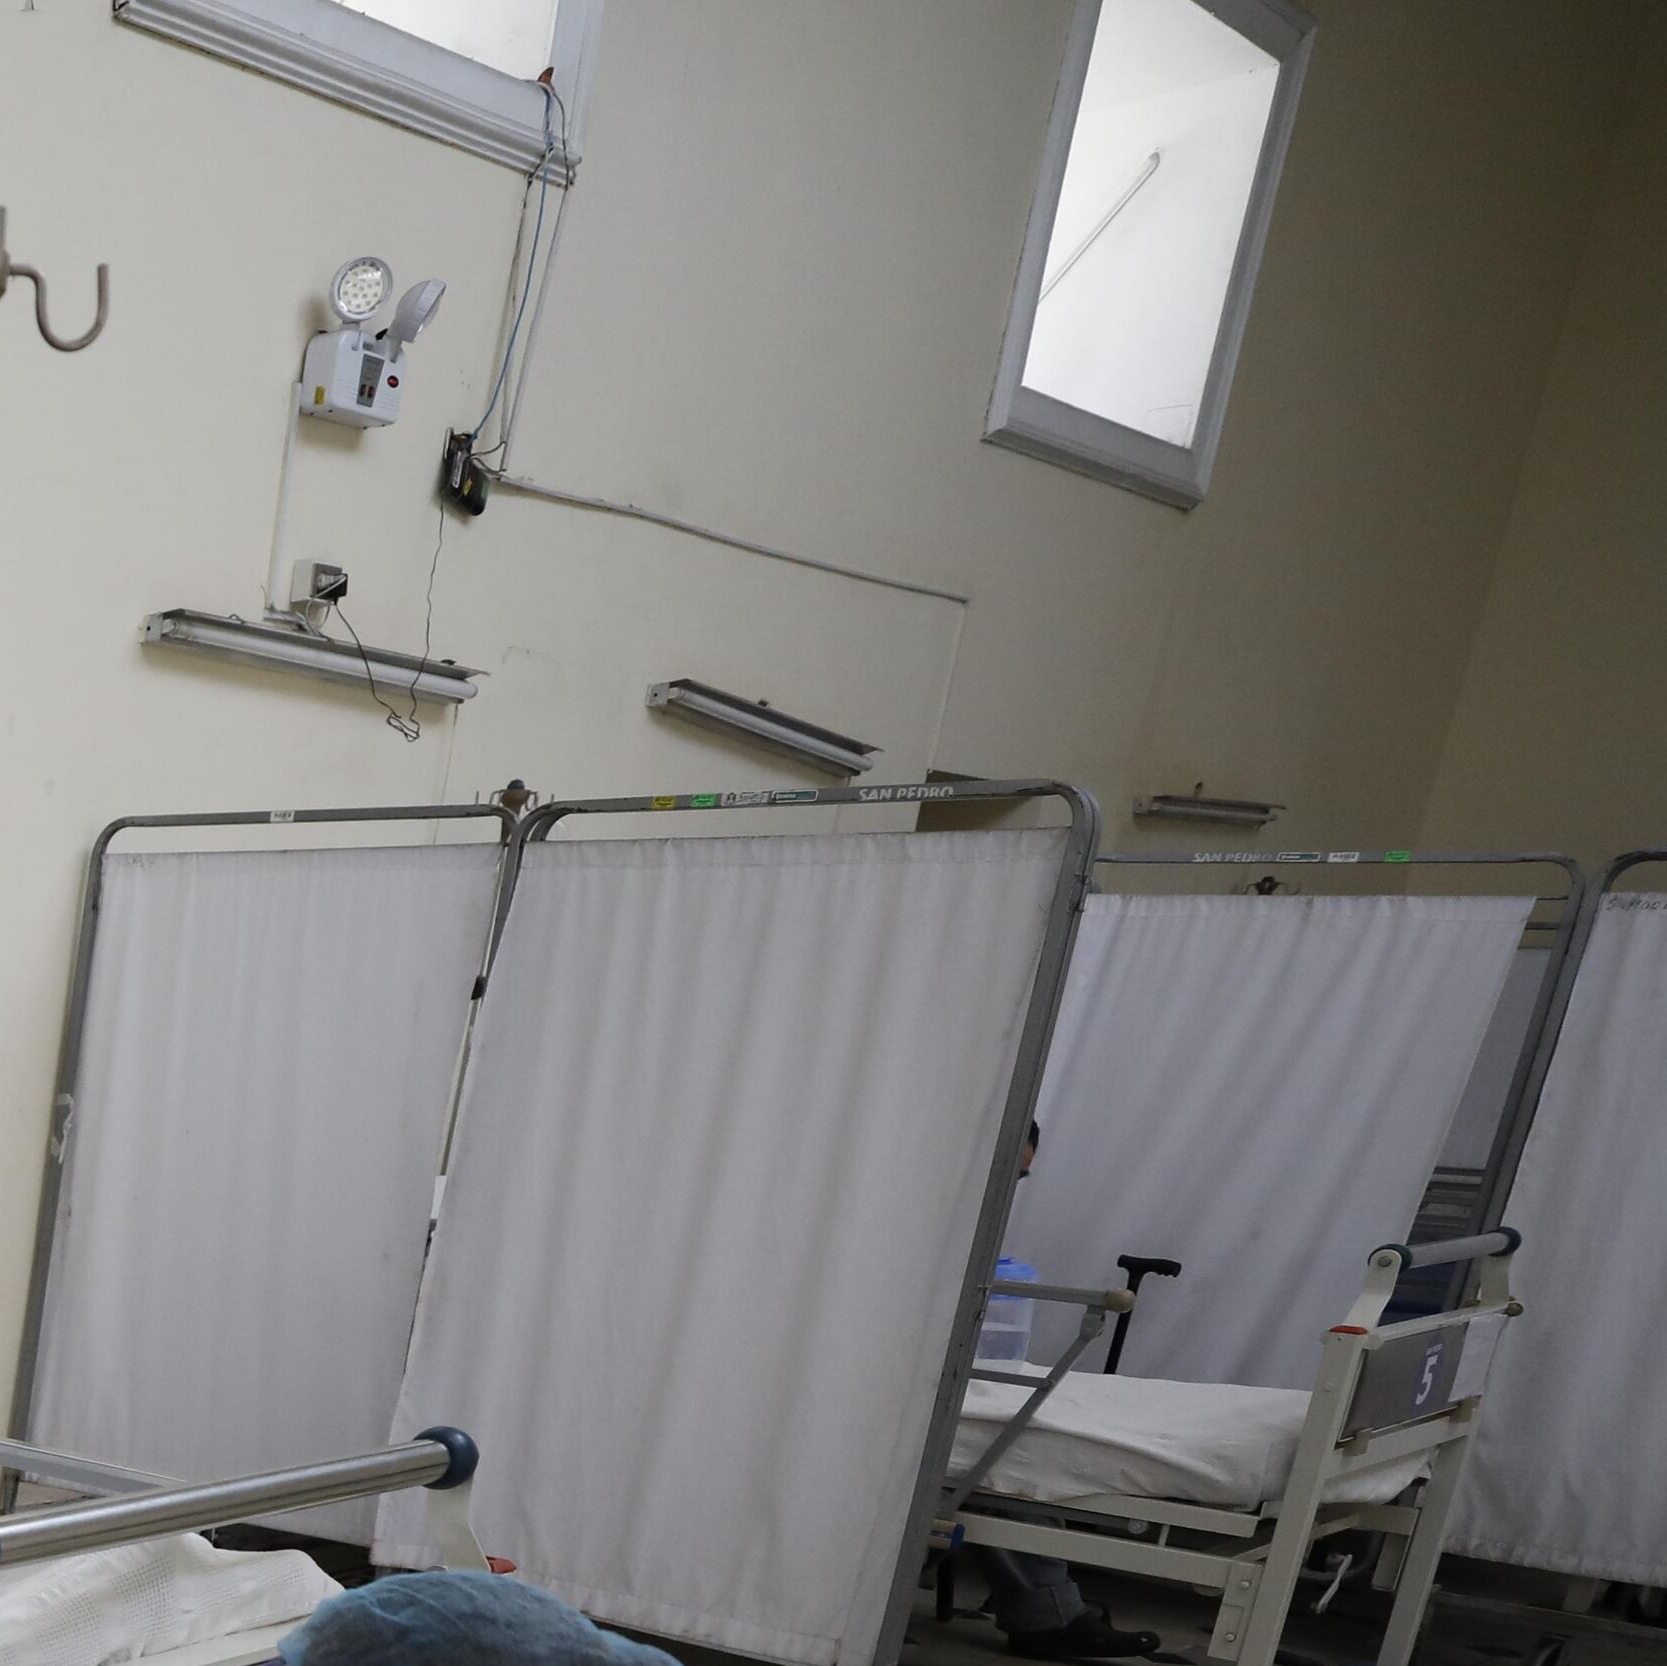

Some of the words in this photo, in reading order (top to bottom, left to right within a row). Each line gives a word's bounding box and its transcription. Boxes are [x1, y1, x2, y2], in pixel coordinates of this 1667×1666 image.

[859, 787, 893, 800] SAN
[896, 785, 954, 799] PEDRO
[1415, 1354, 1439, 1405] 5
